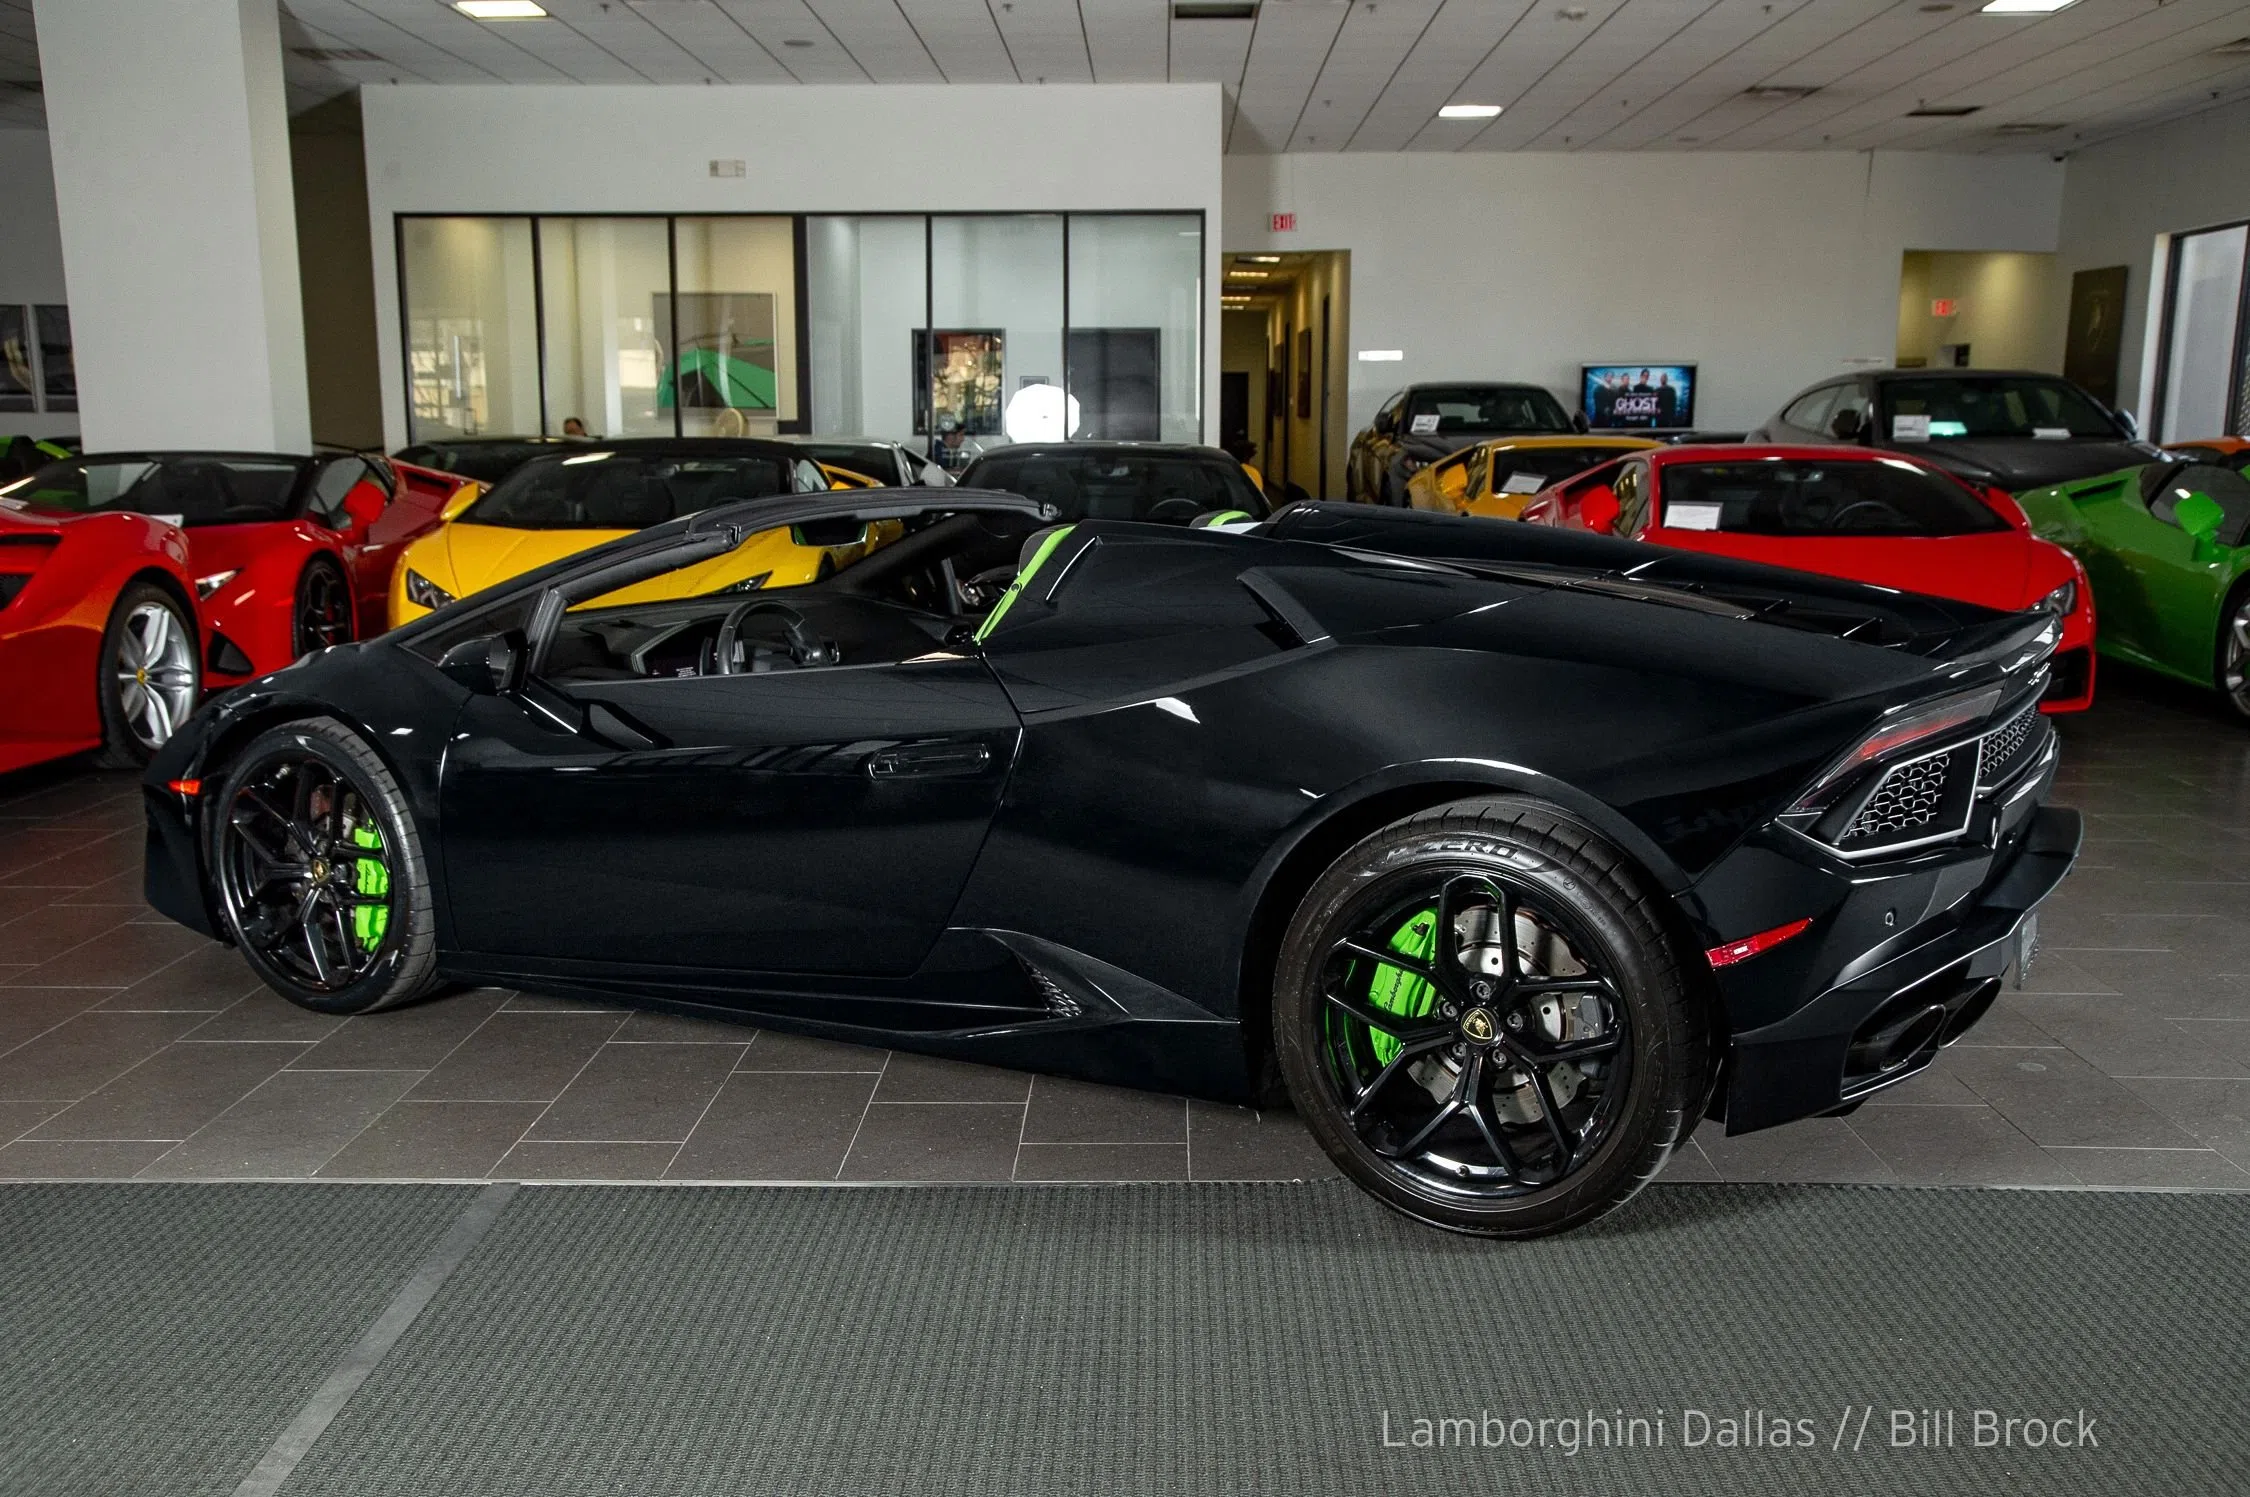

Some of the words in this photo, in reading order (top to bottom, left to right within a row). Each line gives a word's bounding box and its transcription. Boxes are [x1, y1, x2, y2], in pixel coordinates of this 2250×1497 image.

[1273, 213, 1294, 231] EXIT
[1615, 397, 1658, 411] GHOST
[1415, 838, 1519, 859] ZERO
